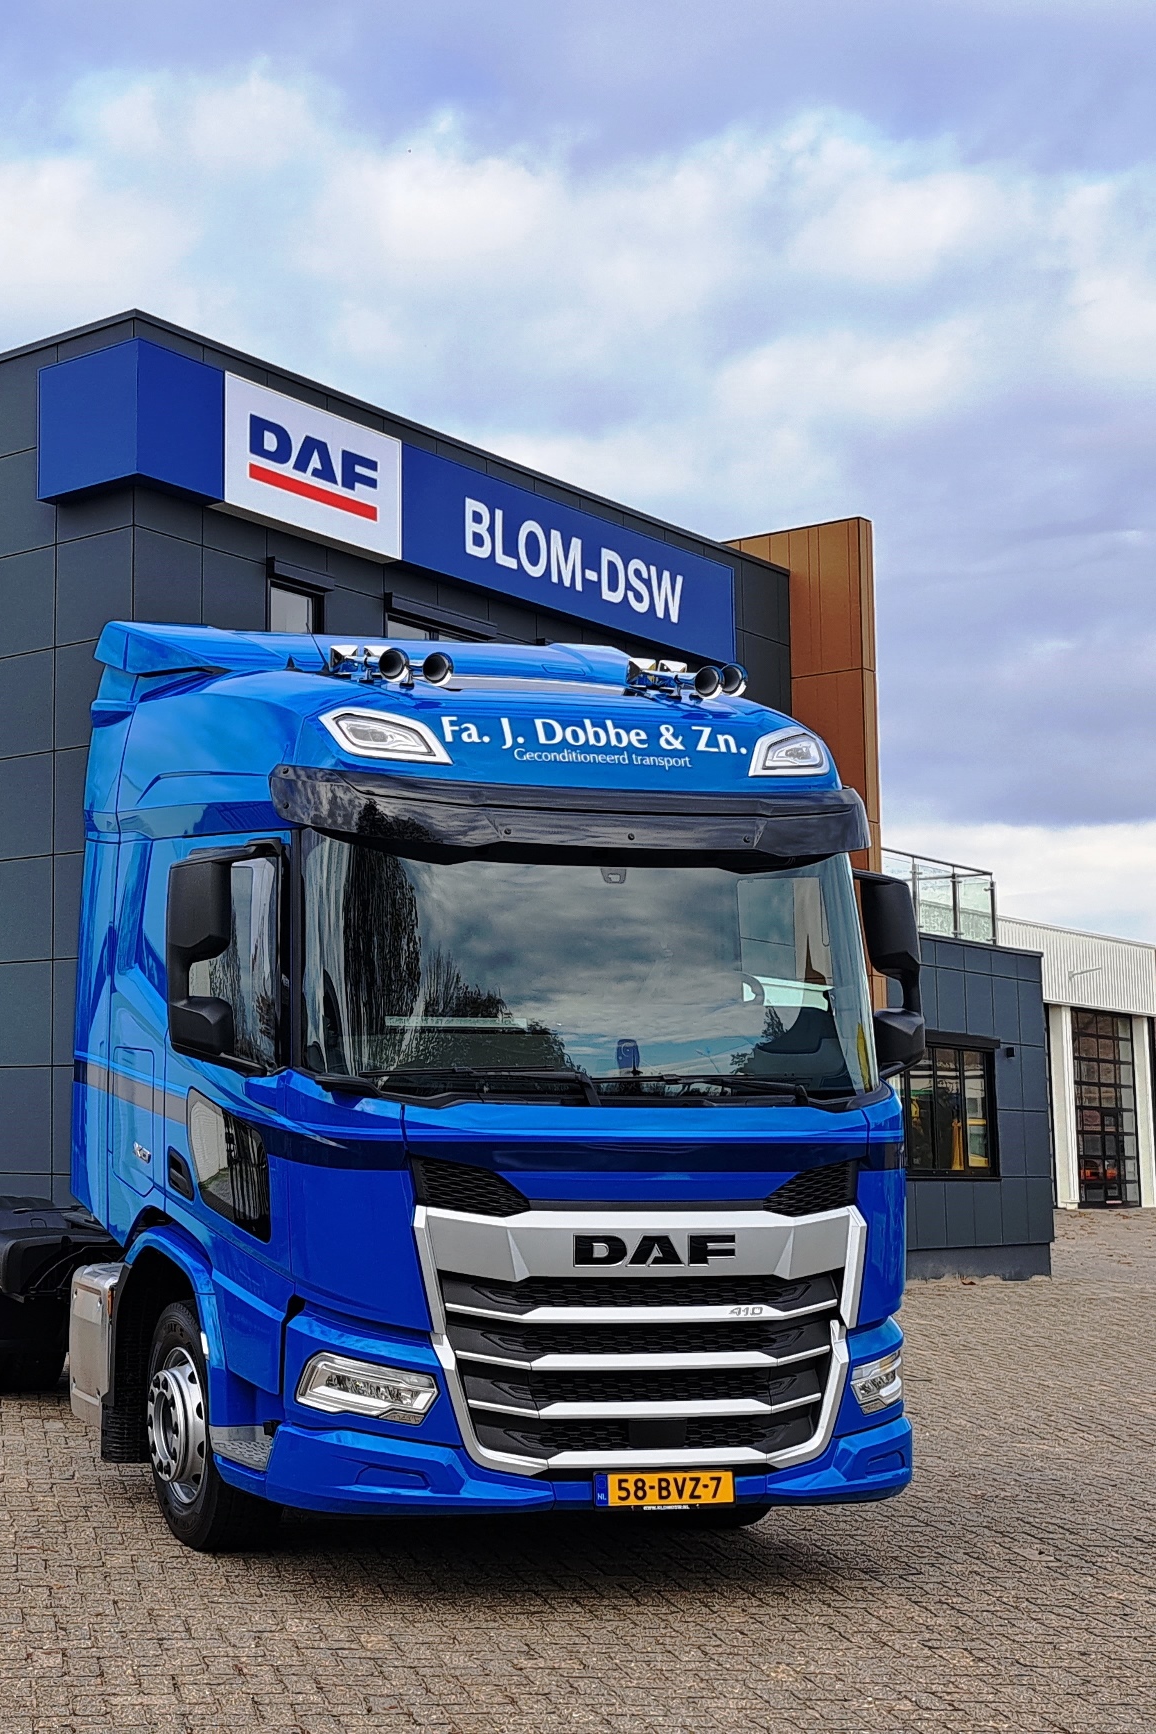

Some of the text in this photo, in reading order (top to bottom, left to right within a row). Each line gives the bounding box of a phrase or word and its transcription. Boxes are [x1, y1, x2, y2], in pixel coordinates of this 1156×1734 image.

[249, 413, 378, 491] DAF
[465, 497, 684, 624] BLOM-DSW
[441, 716, 748, 755] Fa. J. Dobbe & Zn.
[514, 747, 693, 770] Geconditioneerd transport
[573, 1233, 736, 1268] DAF
[729, 1306, 764, 1317] 410
[617, 1476, 722, 1501] 58-BVZ-7
